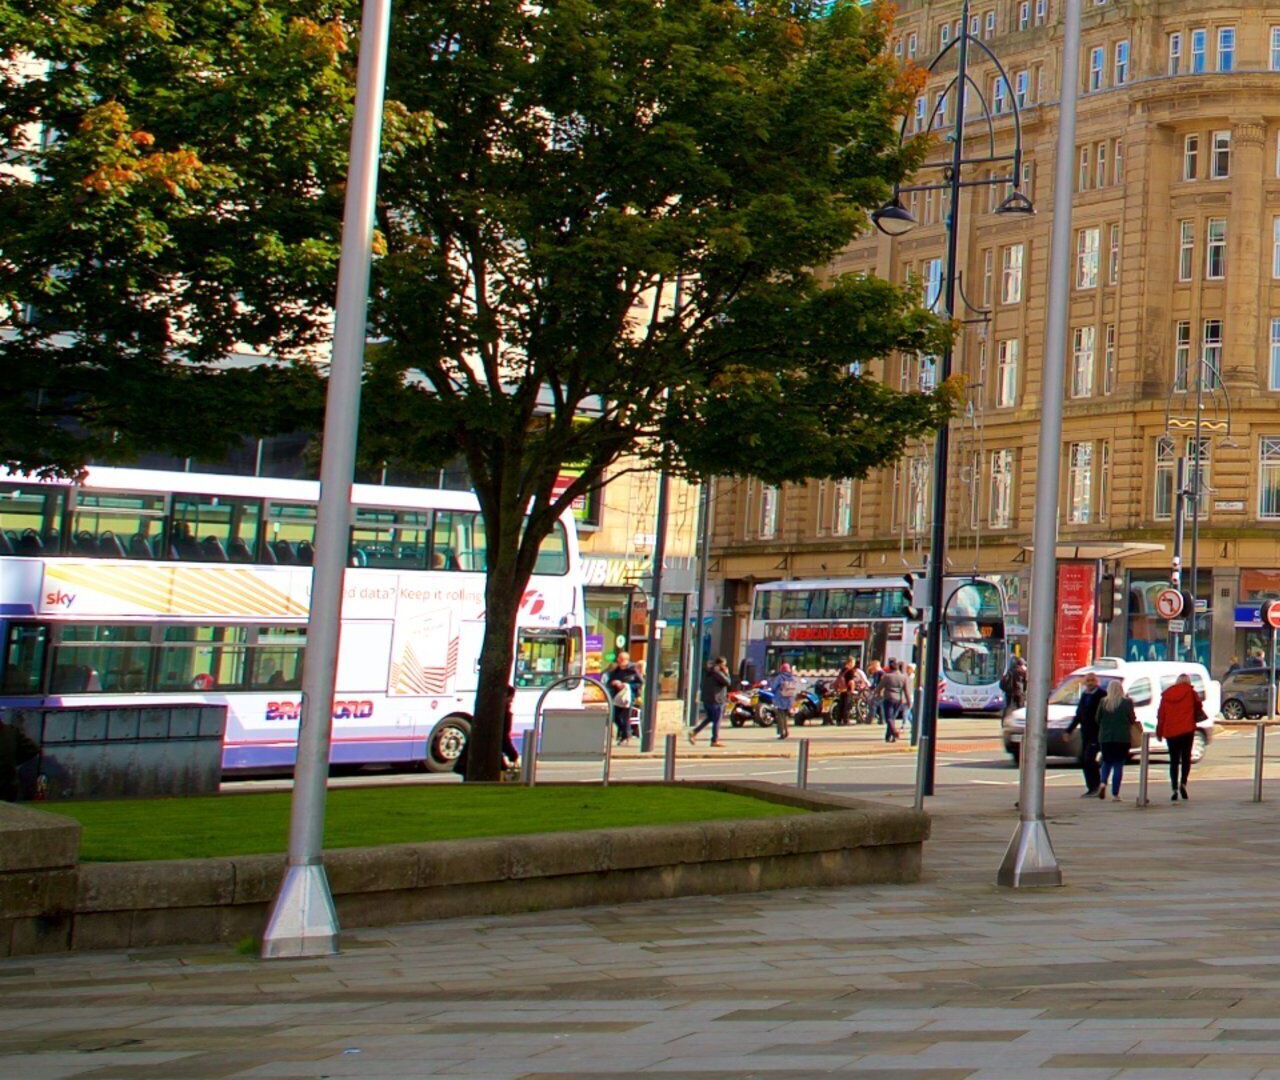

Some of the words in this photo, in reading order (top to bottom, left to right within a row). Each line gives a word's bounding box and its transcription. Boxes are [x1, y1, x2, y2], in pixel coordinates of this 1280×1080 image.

[579, 559, 653, 587] UBWAY
[46, 590, 76, 608] sky
[360, 587, 395, 600] data?
[400, 587, 430, 602] Keep
[434, 588, 442, 600] it
[446, 588, 483, 604] rolling
[265, 700, 374, 720] BRORD
